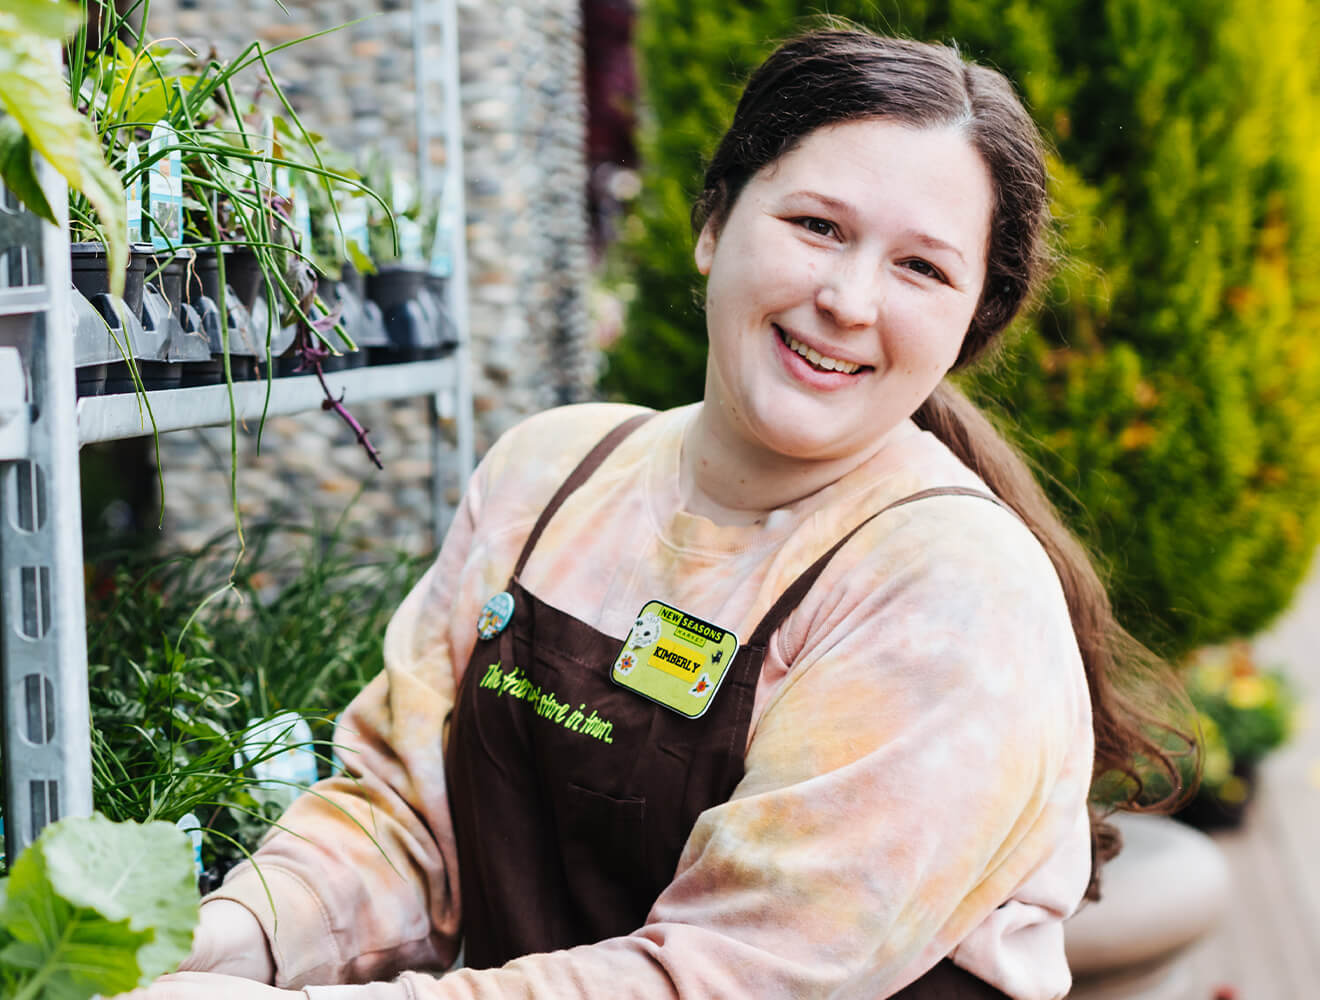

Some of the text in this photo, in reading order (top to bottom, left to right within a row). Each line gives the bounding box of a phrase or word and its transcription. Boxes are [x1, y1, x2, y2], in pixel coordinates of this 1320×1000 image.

[661, 609, 722, 641] NEW SEASONS
[653, 646, 701, 673] KIMBERLY
[480, 660, 503, 689] The
[537, 692, 571, 723] store
[564, 703, 586, 731] in
